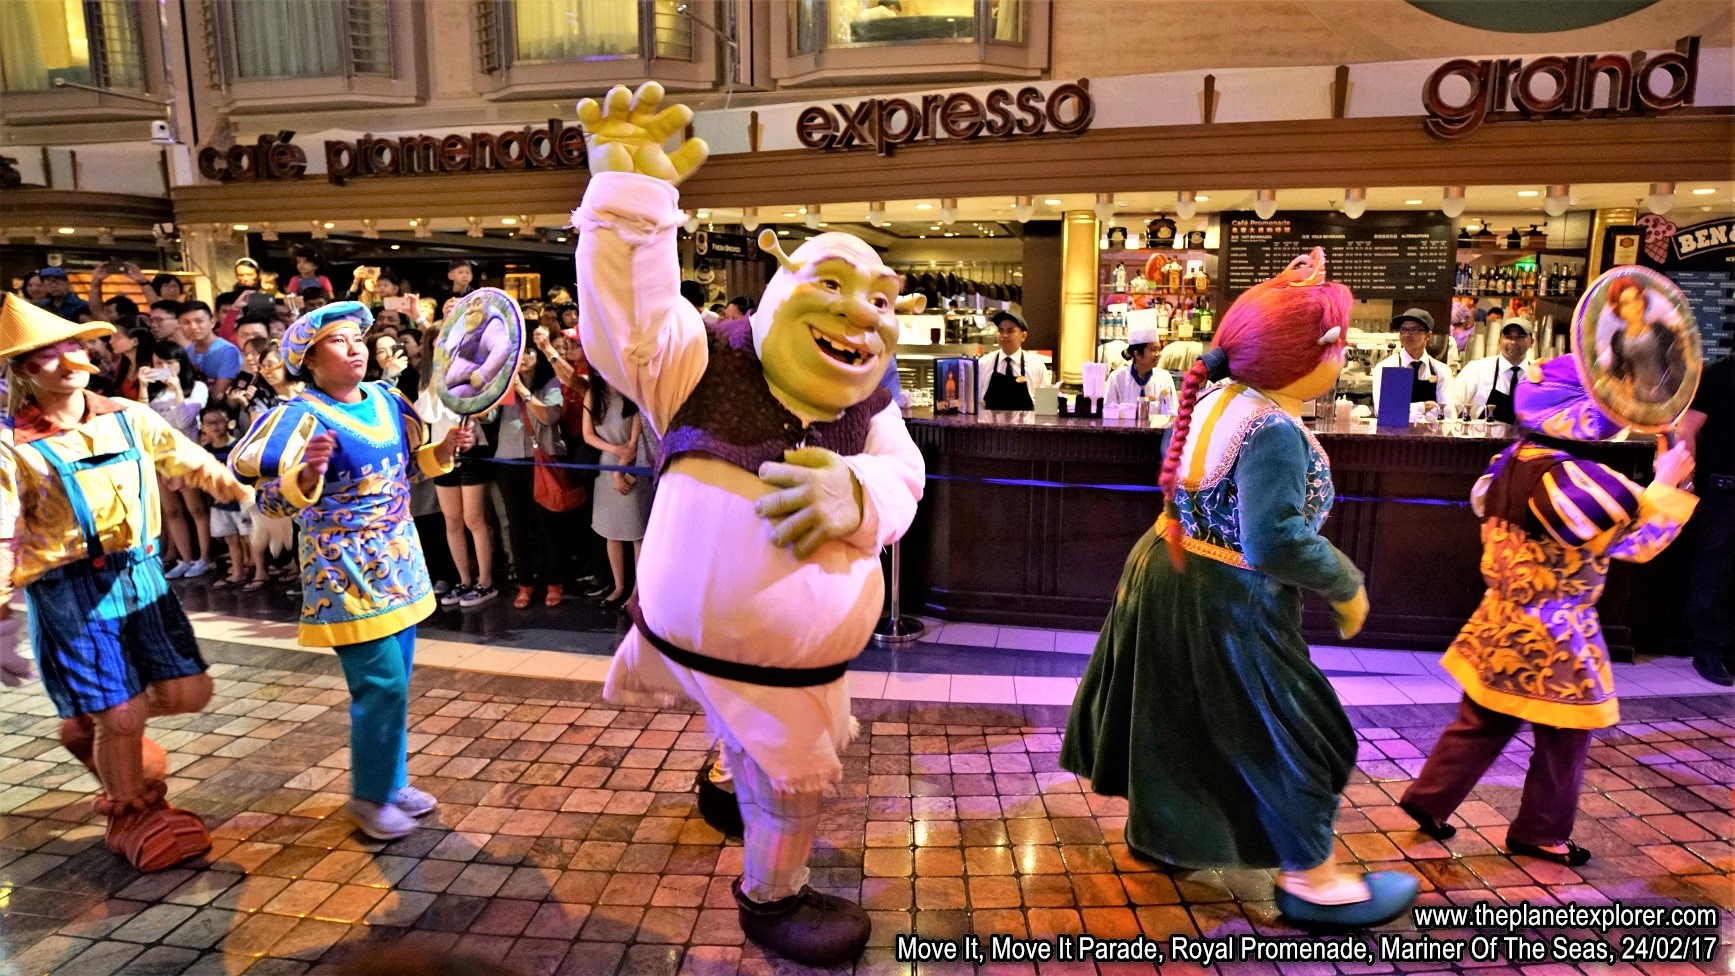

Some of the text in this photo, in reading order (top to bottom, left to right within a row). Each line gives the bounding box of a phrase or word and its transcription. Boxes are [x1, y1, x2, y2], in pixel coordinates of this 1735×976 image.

[797, 79, 1097, 156] expresso
[1422, 37, 1700, 140] grand
[199, 118, 588, 187] café promenade
[1250, 219, 1291, 227] Promenade
[1678, 225, 1728, 254] BEN
